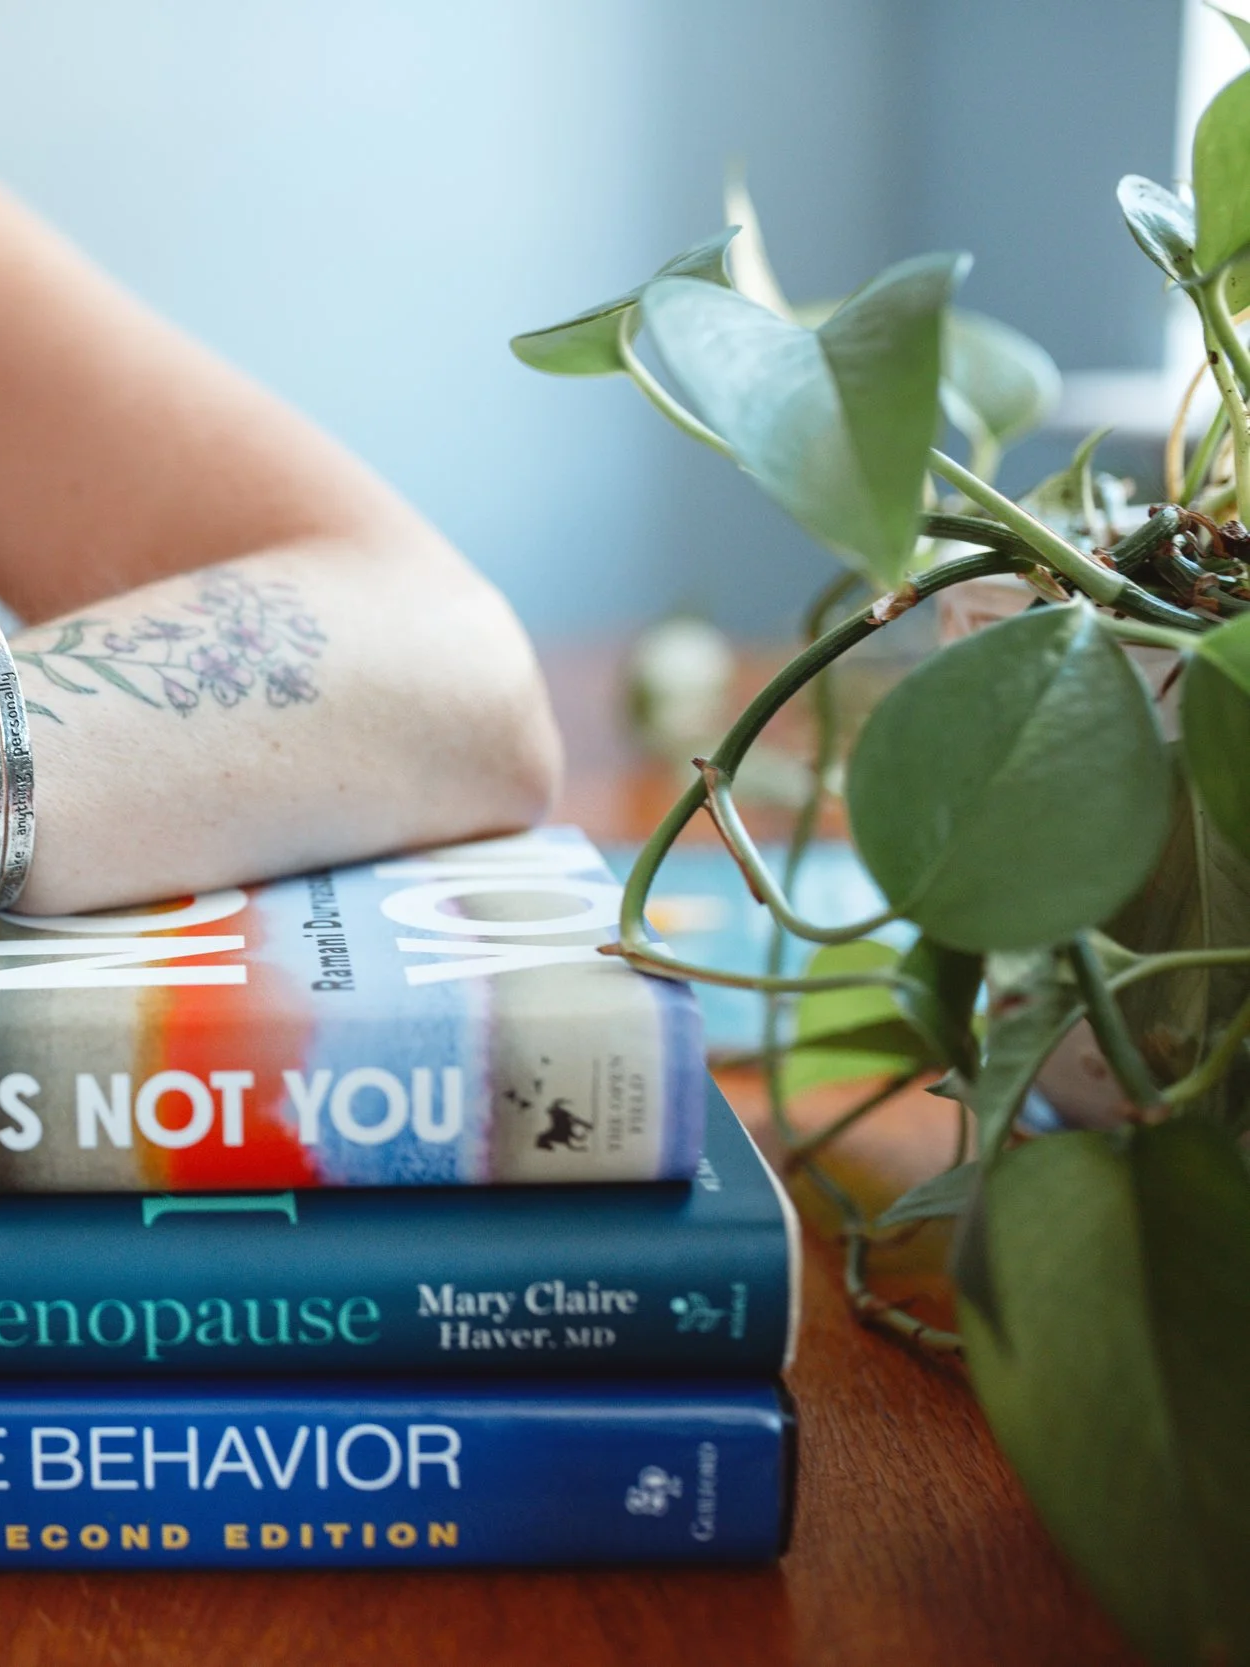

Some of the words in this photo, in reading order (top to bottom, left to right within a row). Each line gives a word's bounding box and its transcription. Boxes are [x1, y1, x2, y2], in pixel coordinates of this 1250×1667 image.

[13, 772, 34, 835] anything
[311, 933, 355, 991] Ramani
[75, 1068, 254, 1150] NOT
[282, 1066, 463, 1146] YOU
[416, 1283, 517, 1324] Mary
[524, 1280, 638, 1315] Claire
[564, 1327, 617, 1348] MD
[30, 1423, 462, 1491] BEHAVIOR
[224, 1522, 459, 1549] EDITION
